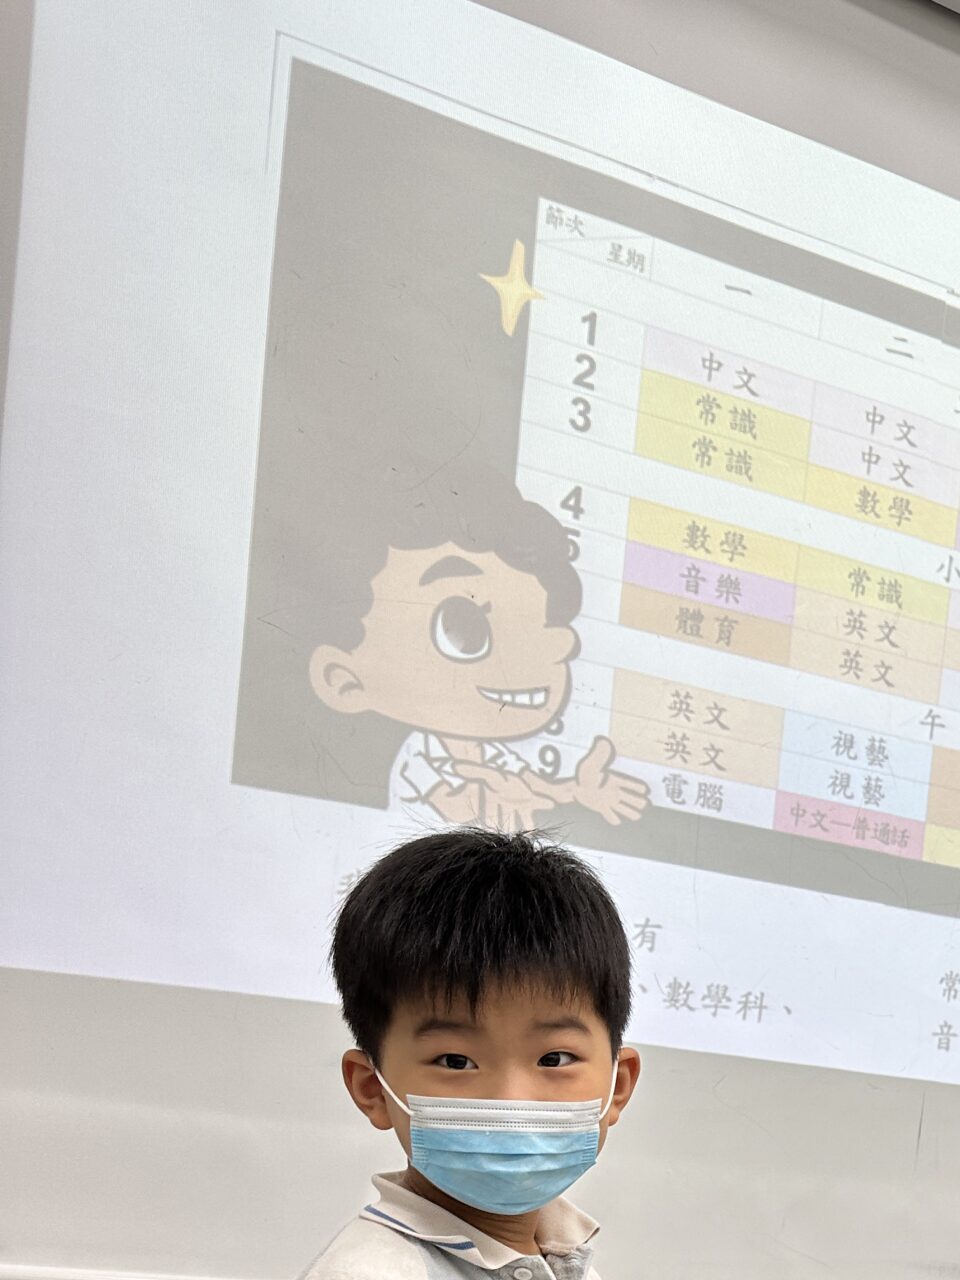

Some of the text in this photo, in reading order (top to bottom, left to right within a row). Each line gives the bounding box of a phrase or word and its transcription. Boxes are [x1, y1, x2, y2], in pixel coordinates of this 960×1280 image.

[545, 205, 586, 238] 節次
[606, 243, 646, 274] 星期
[580, 310, 599, 347] 1
[885, 336, 915, 360] 二
[572, 352, 598, 392] 2
[699, 351, 761, 398] 中文
[569, 396, 592, 434] 3
[695, 392, 759, 441] 常識
[864, 405, 919, 449] 中文
[691, 436, 754, 483] 常識
[860, 445, 915, 490] 中文
[560, 485, 586, 521] 4
[854, 485, 915, 528] 數學
[682, 519, 750, 564] 數學
[678, 563, 744, 606] 音樂
[847, 566, 905, 610] 常識
[674, 606, 740, 648] 體育
[842, 608, 901, 650] 英文
[837, 648, 896, 689] 英文
[667, 689, 732, 733] 英文
[538, 743, 563, 781] 9
[663, 731, 729, 774] 英文
[830, 728, 890, 770] 視藝
[661, 771, 725, 815] 電腦
[826, 768, 888, 809] 視藝
[631, 915, 664, 955] 有
